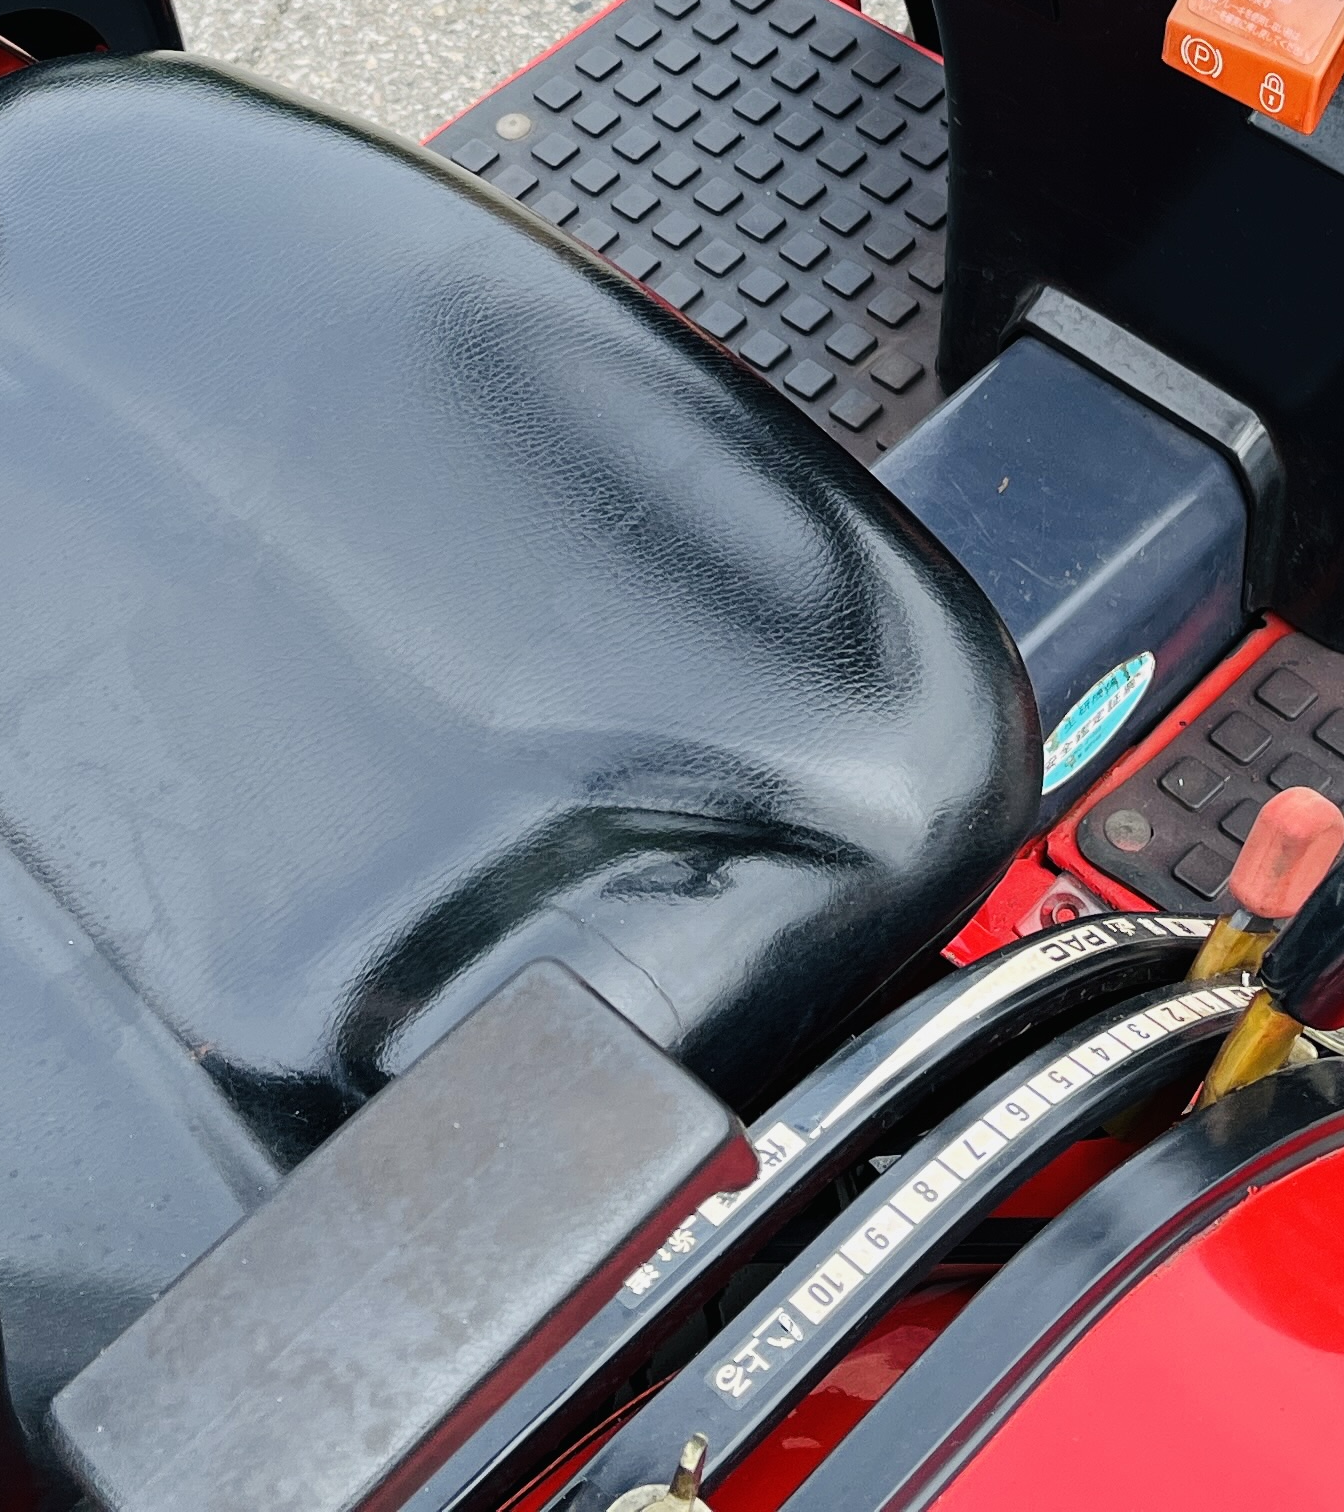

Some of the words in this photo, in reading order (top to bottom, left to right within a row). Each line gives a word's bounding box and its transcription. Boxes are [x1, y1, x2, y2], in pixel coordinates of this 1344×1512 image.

[1042, 929, 1108, 963] PAC
[1160, 1006, 1186, 1023] 2
[1127, 1022, 1151, 1040] 3
[1086, 1043, 1112, 1065] 4
[1047, 1069, 1075, 1090] 5
[1005, 1100, 1032, 1123] 6
[962, 1137, 991, 1160] 7
[911, 1179, 939, 1205] 8
[866, 1226, 892, 1251] 9
[807, 1277, 846, 1308] 10
